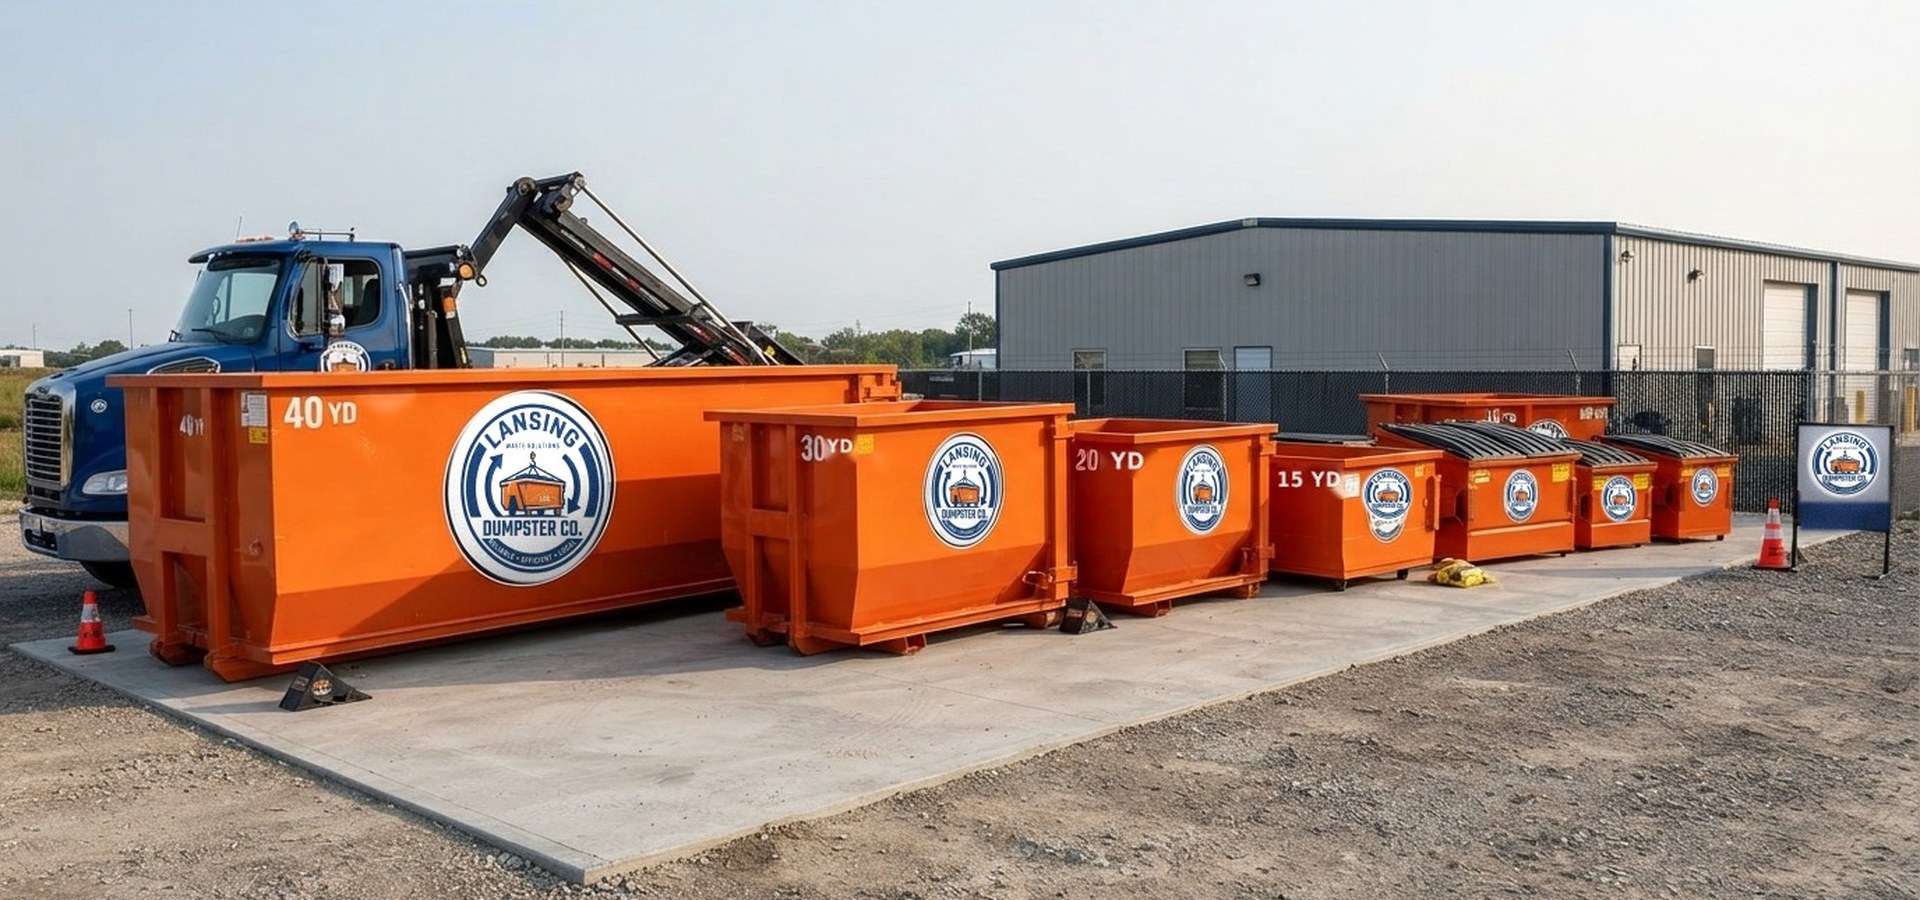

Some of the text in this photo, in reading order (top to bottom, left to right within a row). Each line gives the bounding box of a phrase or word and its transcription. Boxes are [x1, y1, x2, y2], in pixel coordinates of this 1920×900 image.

[283, 395, 323, 429] 40
[327, 401, 357, 425] YD
[484, 411, 580, 449] LANSING
[801, 434, 825, 462] 30
[827, 438, 853, 454] YD
[1823, 435, 1867, 450] LANSING
[942, 446, 987, 468] LANSING
[1075, 448, 1144, 471] 20 YD
[1277, 471, 1303, 488] 15
[1311, 471, 1341, 488] YD
[941, 508, 976, 519] DUMPSTER
[482, 519, 583, 537] DUMPSTER CO.
